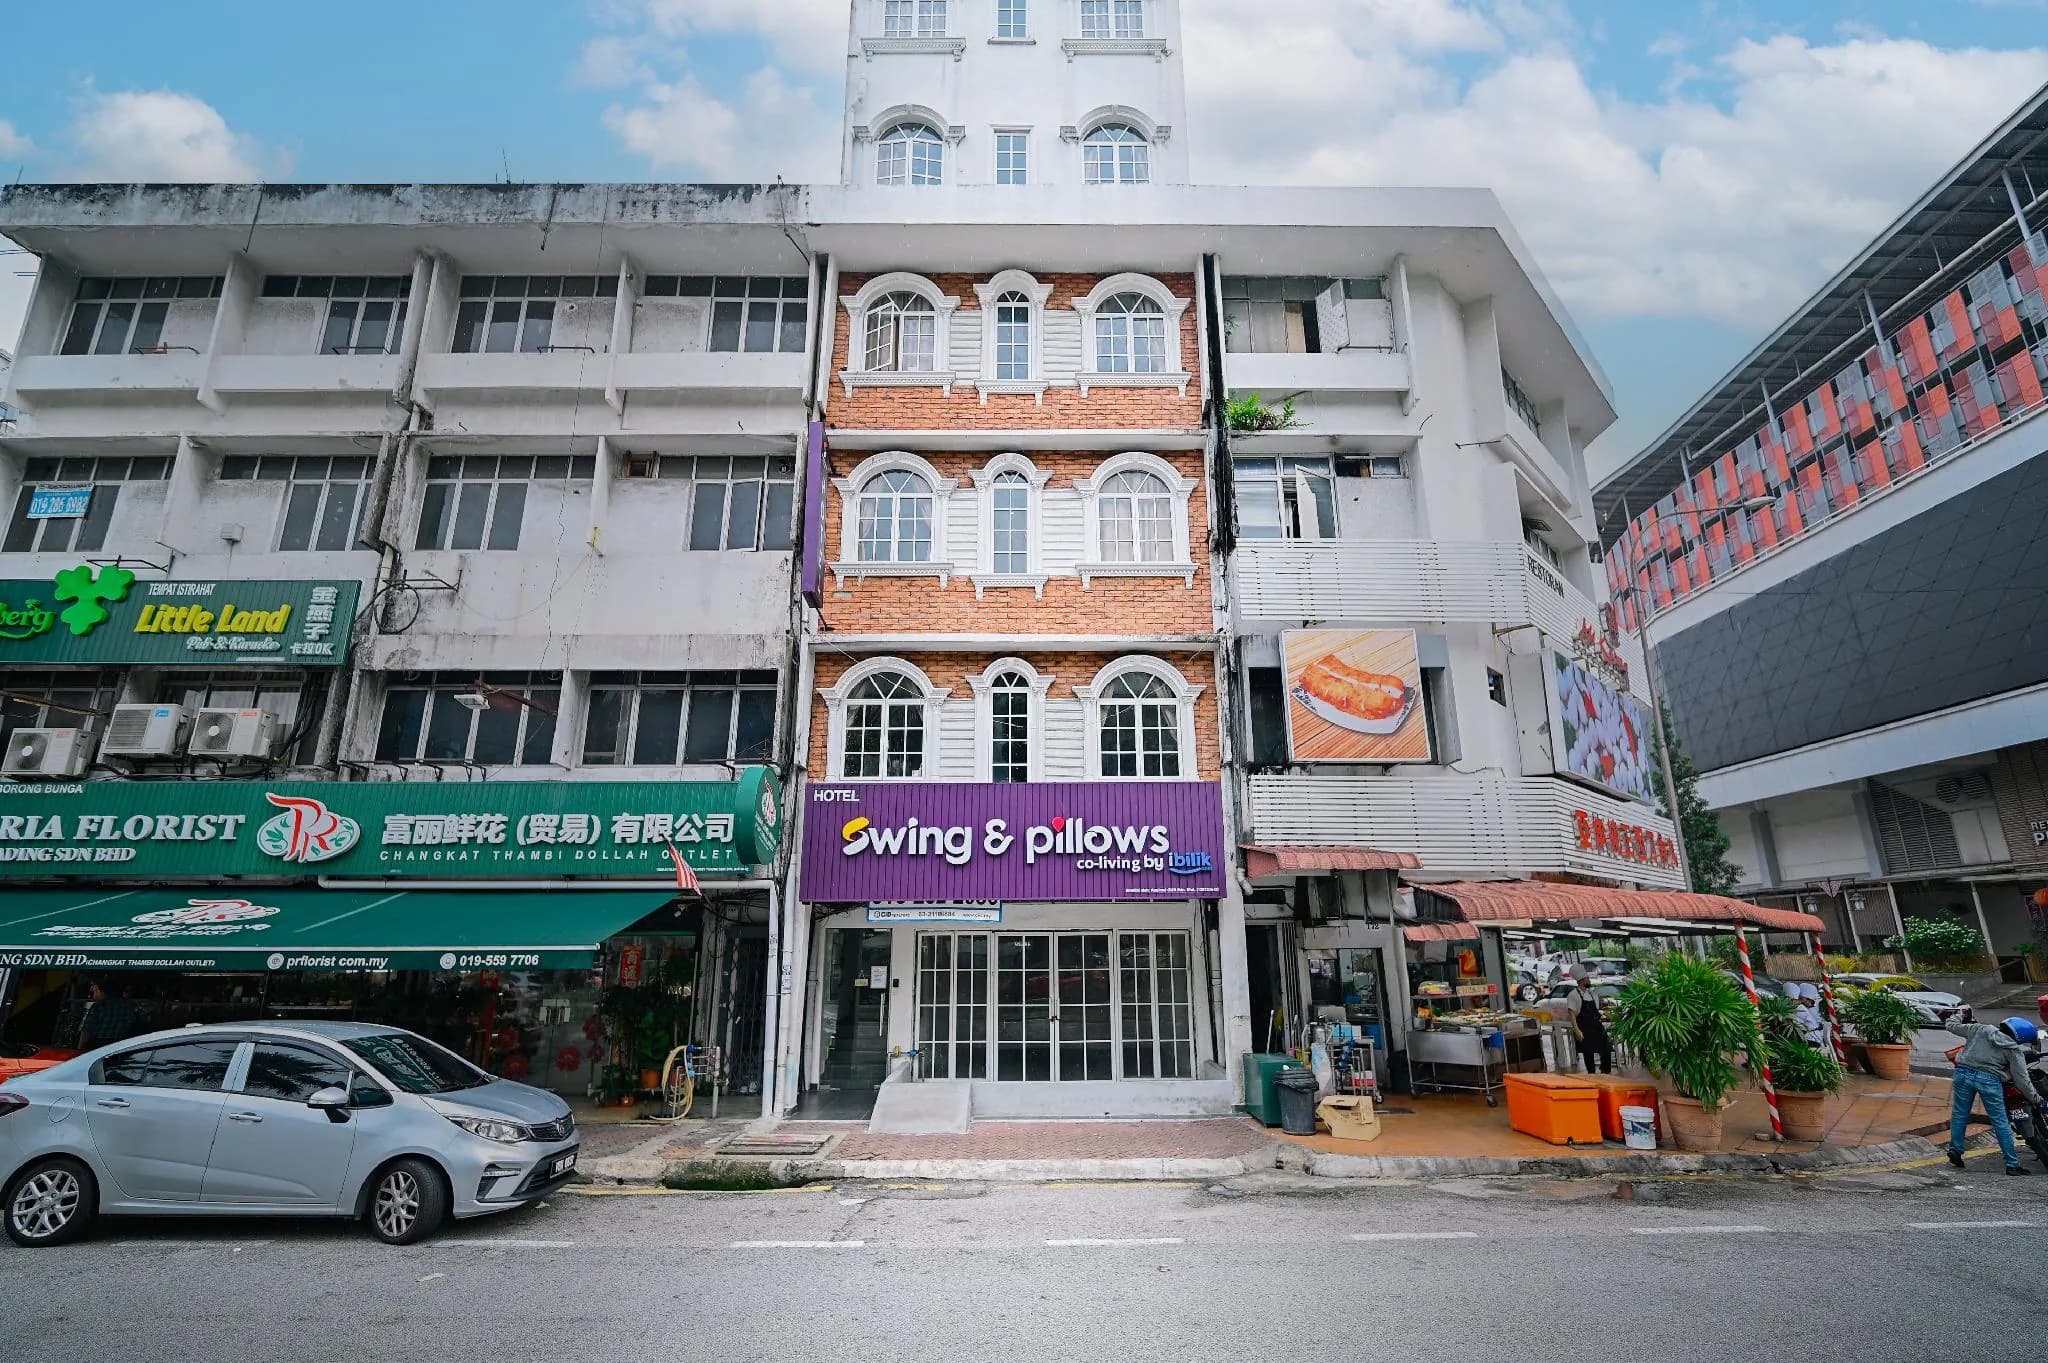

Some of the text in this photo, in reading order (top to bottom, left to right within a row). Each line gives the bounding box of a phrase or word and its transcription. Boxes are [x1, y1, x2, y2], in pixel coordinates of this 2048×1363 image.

[1527, 554, 1564, 599] RESTORAN
[148, 583, 216, 596] TEMPAT ISTIRAHAT
[133, 603, 292, 633] Little Land
[186, 637, 214, 650] Pub
[44, 784, 84, 794] BUNGA
[813, 789, 860, 802] HOTEL
[73, 814, 246, 841] FLORIST
[382, 813, 509, 845] 富丽鲜花
[611, 812, 735, 844] 有限公司
[842, 816, 1170, 865] Swing & pillows
[54, 847, 95, 861] SDN
[94, 847, 137, 861] BHD
[379, 850, 480, 861] CHANGKAT
[493, 850, 563, 861] THAMBI
[575, 850, 648, 860] DOLLAH
[1076, 851, 1212, 873] co-living by ibilik
[23, 954, 55, 966] SDN
[54, 954, 87, 966] BHD
[185, 959, 216, 967] OUTLET)
[286, 955, 337, 970] prflorist
[459, 954, 540, 967] 019-559 7706
